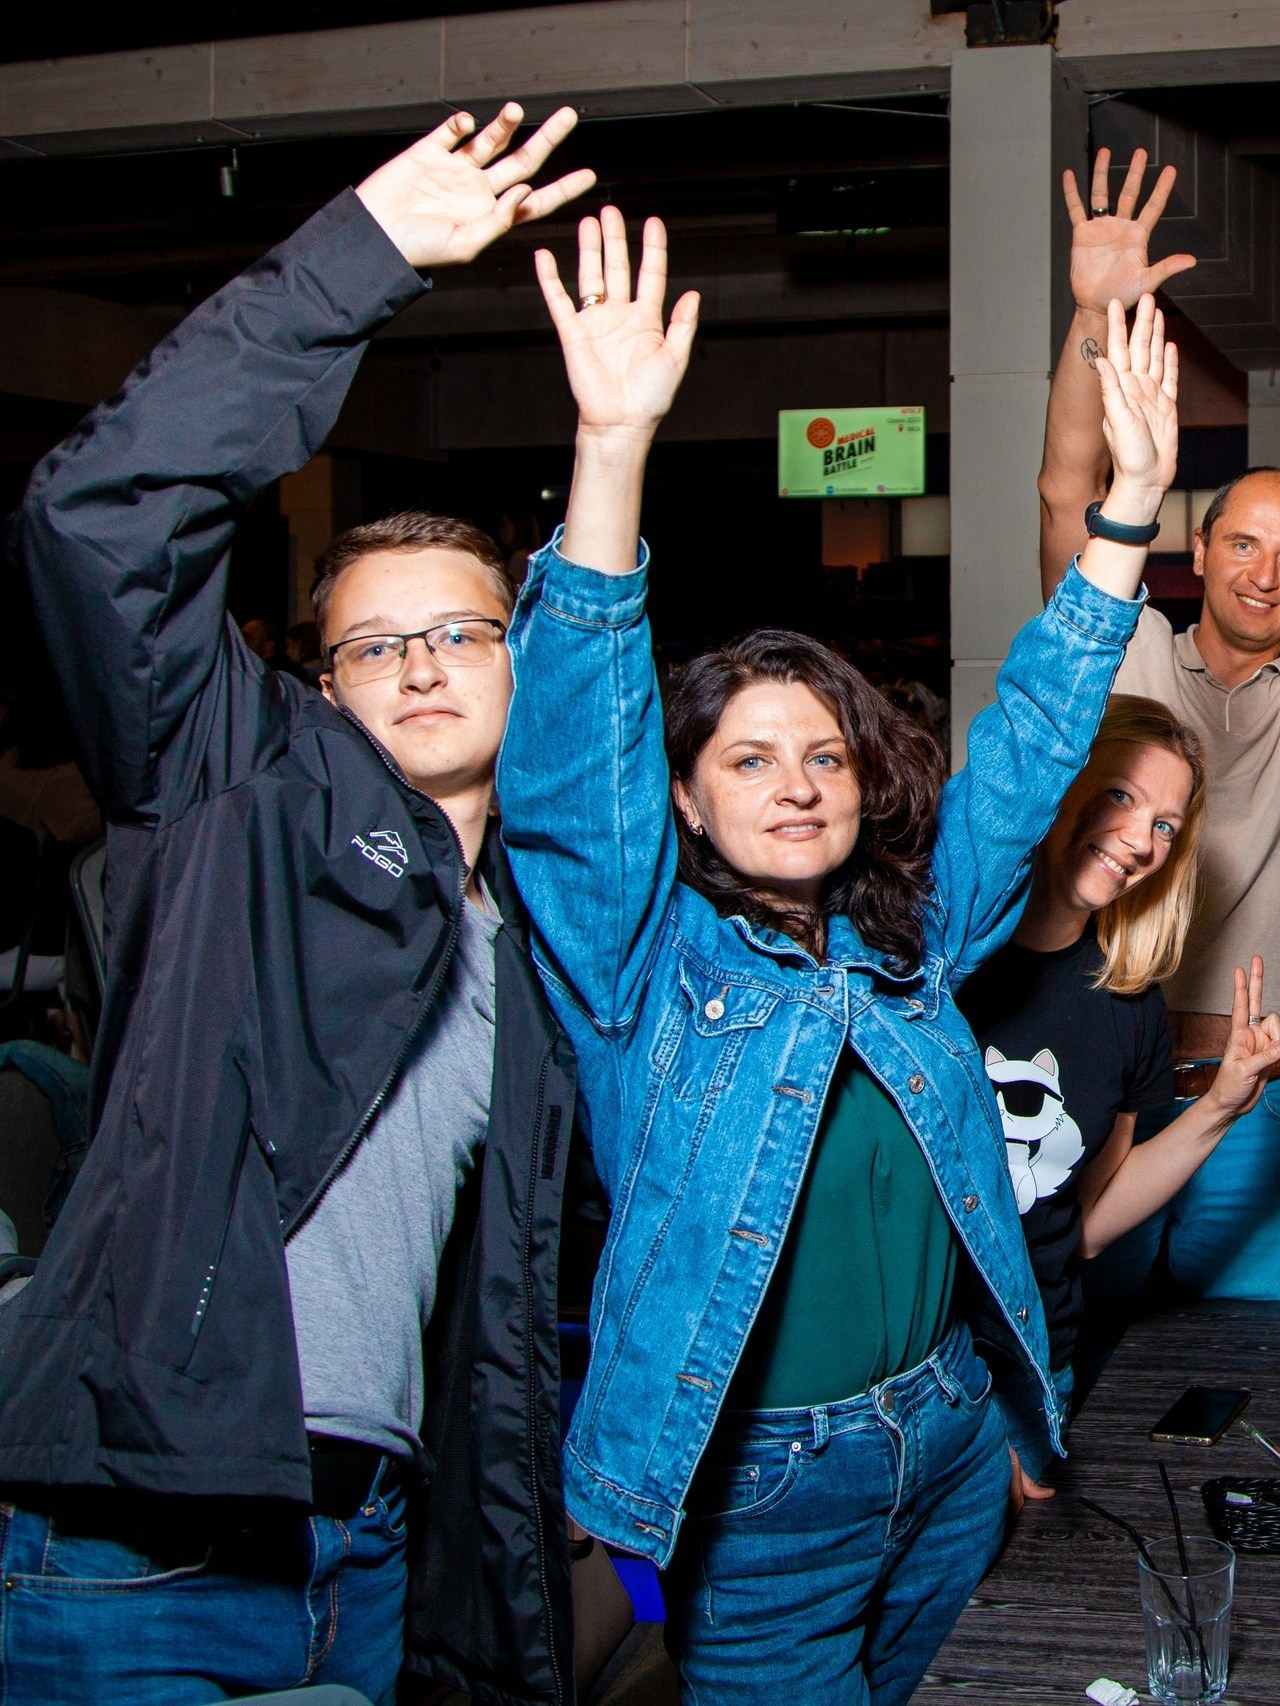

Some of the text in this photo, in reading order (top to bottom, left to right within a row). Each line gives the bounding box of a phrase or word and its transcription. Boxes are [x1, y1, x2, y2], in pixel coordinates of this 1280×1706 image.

[837, 427, 875, 445] MEDICAL
[823, 436, 875, 466] BRAIN
[823, 458, 857, 476] BATTLE
[351, 834, 404, 878] POGO
